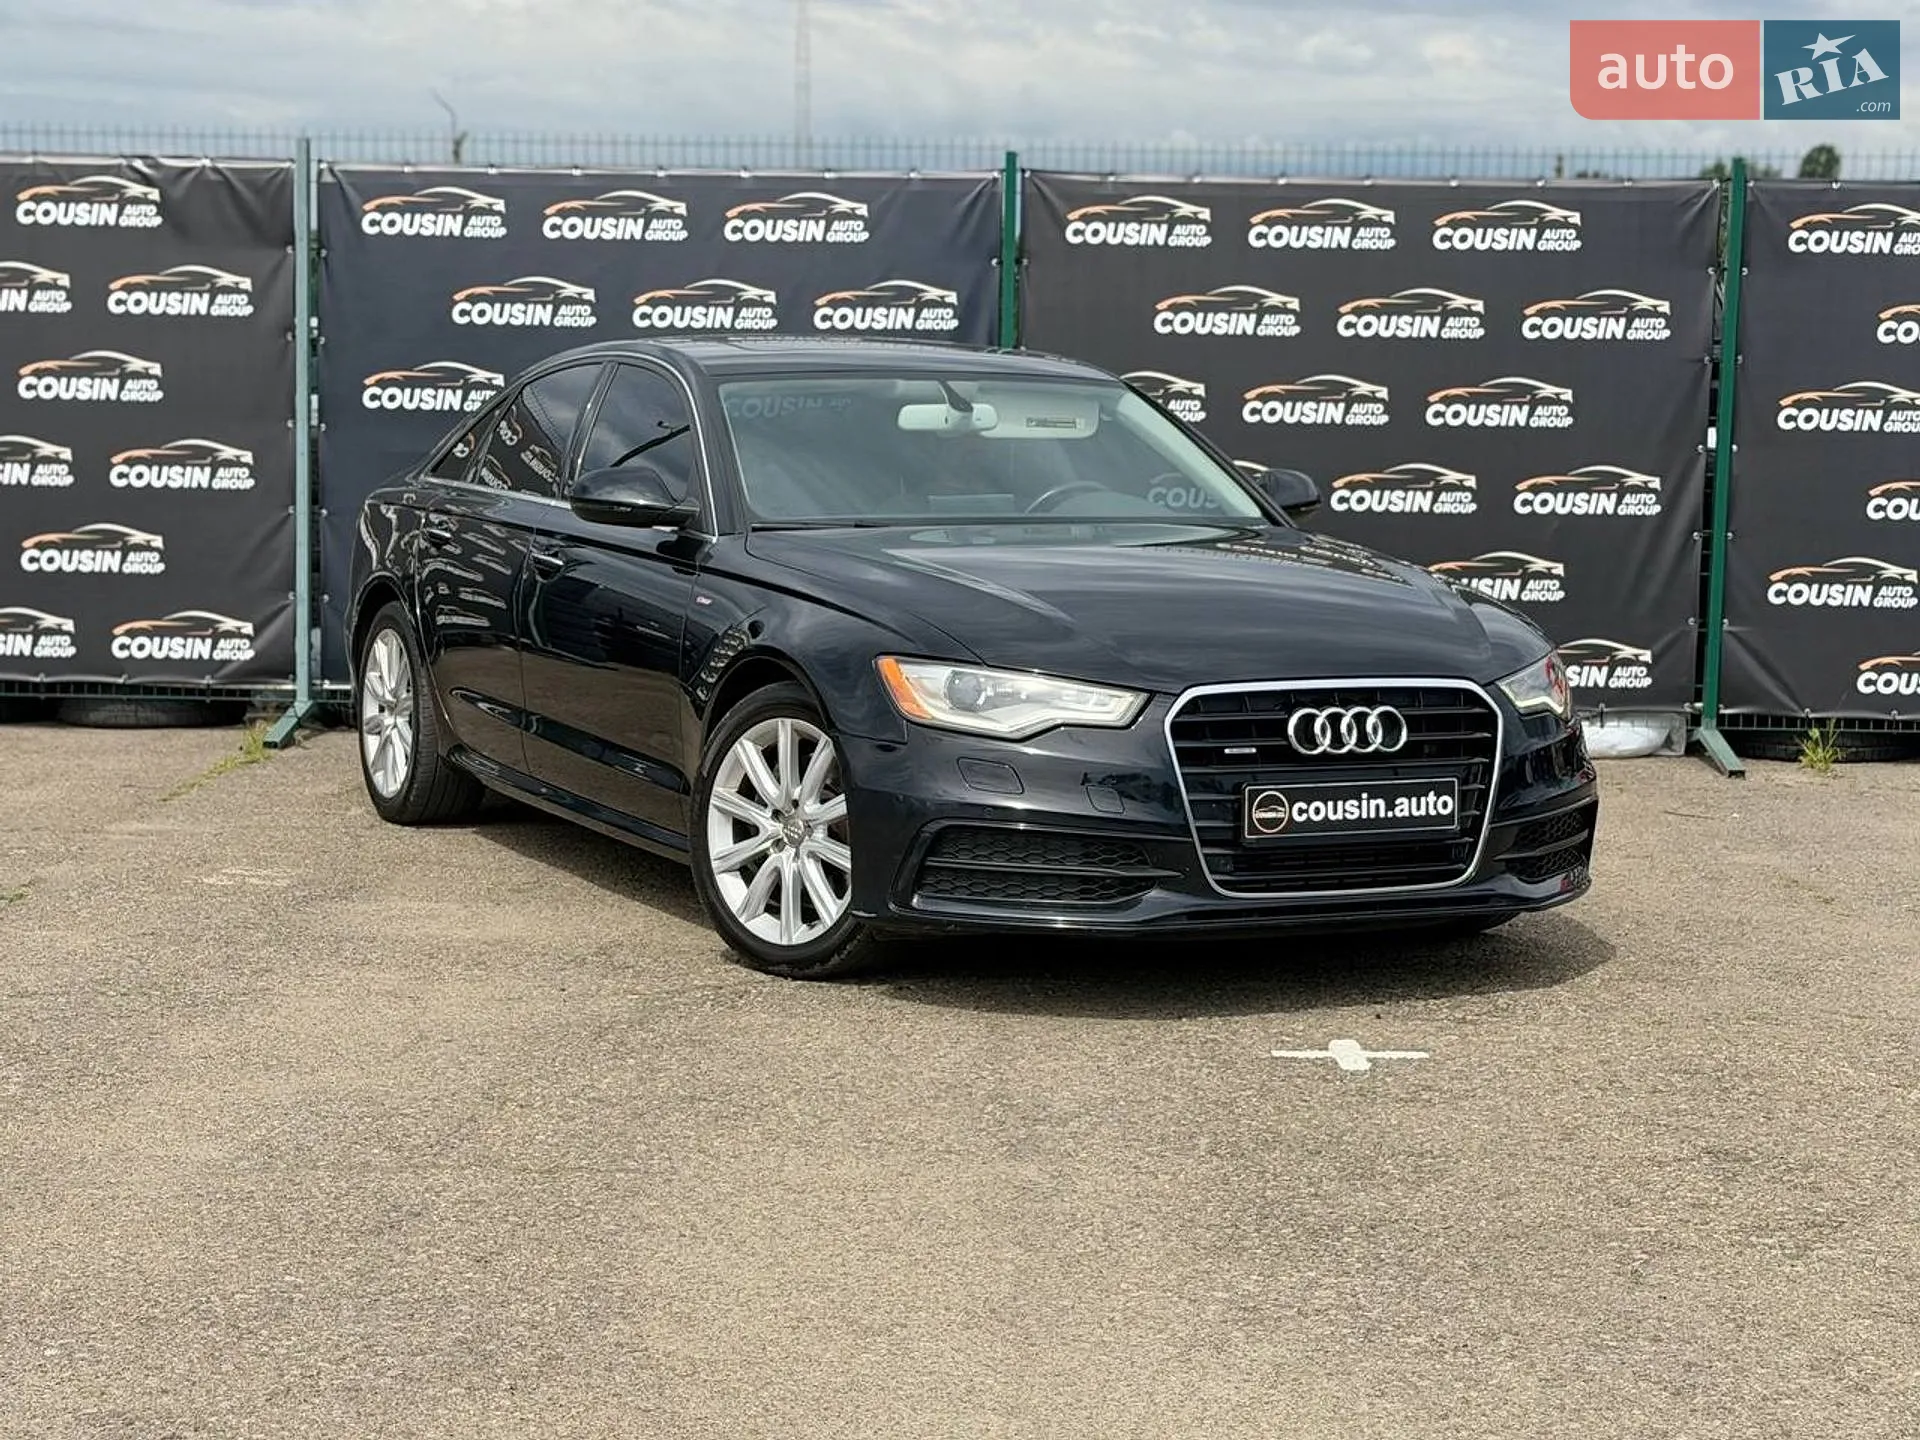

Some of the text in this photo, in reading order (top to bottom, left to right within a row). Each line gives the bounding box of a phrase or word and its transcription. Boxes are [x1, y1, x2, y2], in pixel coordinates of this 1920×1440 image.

[16, 201, 119, 226] COUSIN
[123, 204, 157, 215] AUTO
[119, 215, 163, 227] GROUP
[361, 212, 464, 236] COUSIN
[468, 215, 502, 226] AUTO
[649, 219, 683, 231] AUTO
[463, 226, 507, 238] GROUP
[542, 217, 645, 240] COUSIN
[724, 219, 827, 242] COUSIN
[830, 221, 866, 233] AUTO
[1172, 224, 1207, 236] AUTO
[1356, 227, 1390, 239] AUTO
[645, 231, 688, 241] GROUP
[826, 233, 869, 242] GROUP
[1065, 222, 1168, 245] COUSIN
[1248, 225, 1351, 248] COUSIN
[1433, 228, 1536, 250] COUSIN
[1540, 230, 1575, 242] AUTO
[1168, 236, 1212, 247] GROUP
[1352, 239, 1396, 249] GROUP
[1537, 242, 1582, 251] GROUP
[1788, 230, 1894, 254] COUSIN
[33, 290, 67, 300] AUTO
[214, 294, 248, 305] AUTO
[26, 300, 72, 312] GROUP
[107, 291, 210, 315] COUSIN
[210, 305, 254, 316] GROUP
[452, 302, 555, 326] COUSIN
[557, 305, 591, 316] AUTO
[738, 308, 775, 320] AUTO
[919, 310, 956, 322] AUTO
[553, 316, 596, 327] GROUP
[632, 306, 736, 328] COUSIN
[813, 308, 917, 330] COUSIN
[1261, 314, 1295, 326] AUTO
[1445, 317, 1479, 329] AUTO
[734, 320, 777, 329] GROUP
[915, 322, 958, 330] GROUP
[1154, 312, 1257, 335] COUSIN
[1337, 315, 1440, 338] COUSIN
[1522, 317, 1625, 340] COUSIN
[1630, 319, 1664, 331] AUTO
[1256, 326, 1301, 336] GROUP
[1441, 329, 1485, 339] GROUP
[1626, 331, 1670, 340] GROUP
[18, 376, 120, 400] COUSIN
[124, 379, 158, 390] AUTO
[120, 390, 163, 402] GROUP
[362, 387, 465, 410] COUSIN
[468, 390, 497, 401] AUT
[1168, 400, 1201, 412] AUTO
[1349, 403, 1384, 415] AUTO
[1533, 406, 1568, 418] AUTO
[1174, 411, 1206, 422] OUP
[1242, 401, 1345, 424] COUSIN
[1426, 404, 1529, 426] COUSIN
[1345, 415, 1389, 425] GROUP
[1529, 418, 1573, 427] GROUP
[1777, 408, 1884, 431] COUSIN
[35, 464, 69, 475] AUTO
[216, 467, 250, 478] AUTO
[31, 475, 74, 486] GROUP
[110, 464, 212, 488] COUSIN
[212, 478, 255, 489] GROUP
[1331, 490, 1434, 512] COUSIN
[1437, 492, 1472, 504] AUTO
[1514, 493, 1617, 515] COUSIN
[1620, 495, 1656, 507] AUTO
[1433, 504, 1477, 513] GROUP
[1617, 507, 1661, 515] GROUP
[21, 549, 123, 572] COUSIN
[126, 551, 160, 563] AUTO
[122, 563, 165, 574] GROUP
[1526, 580, 1559, 591] AUTO
[1878, 586, 1913, 597] AUTO
[1522, 591, 1565, 601] GROUP
[1767, 583, 1874, 606] COUSIN
[1873, 597, 1919, 609] GROUP
[38, 635, 71, 646] AUTO
[217, 638, 253, 650] AUTO
[34, 646, 76, 657] GROUP
[111, 636, 214, 659] COUSIN
[212, 650, 255, 661] GROUP
[1565, 665, 1609, 687] SIN
[1613, 666, 1647, 677] AUTO
[1608, 677, 1652, 688] GROUP
[1857, 672, 1920, 695] COU
[1292, 790, 1455, 823] cousin.auto
